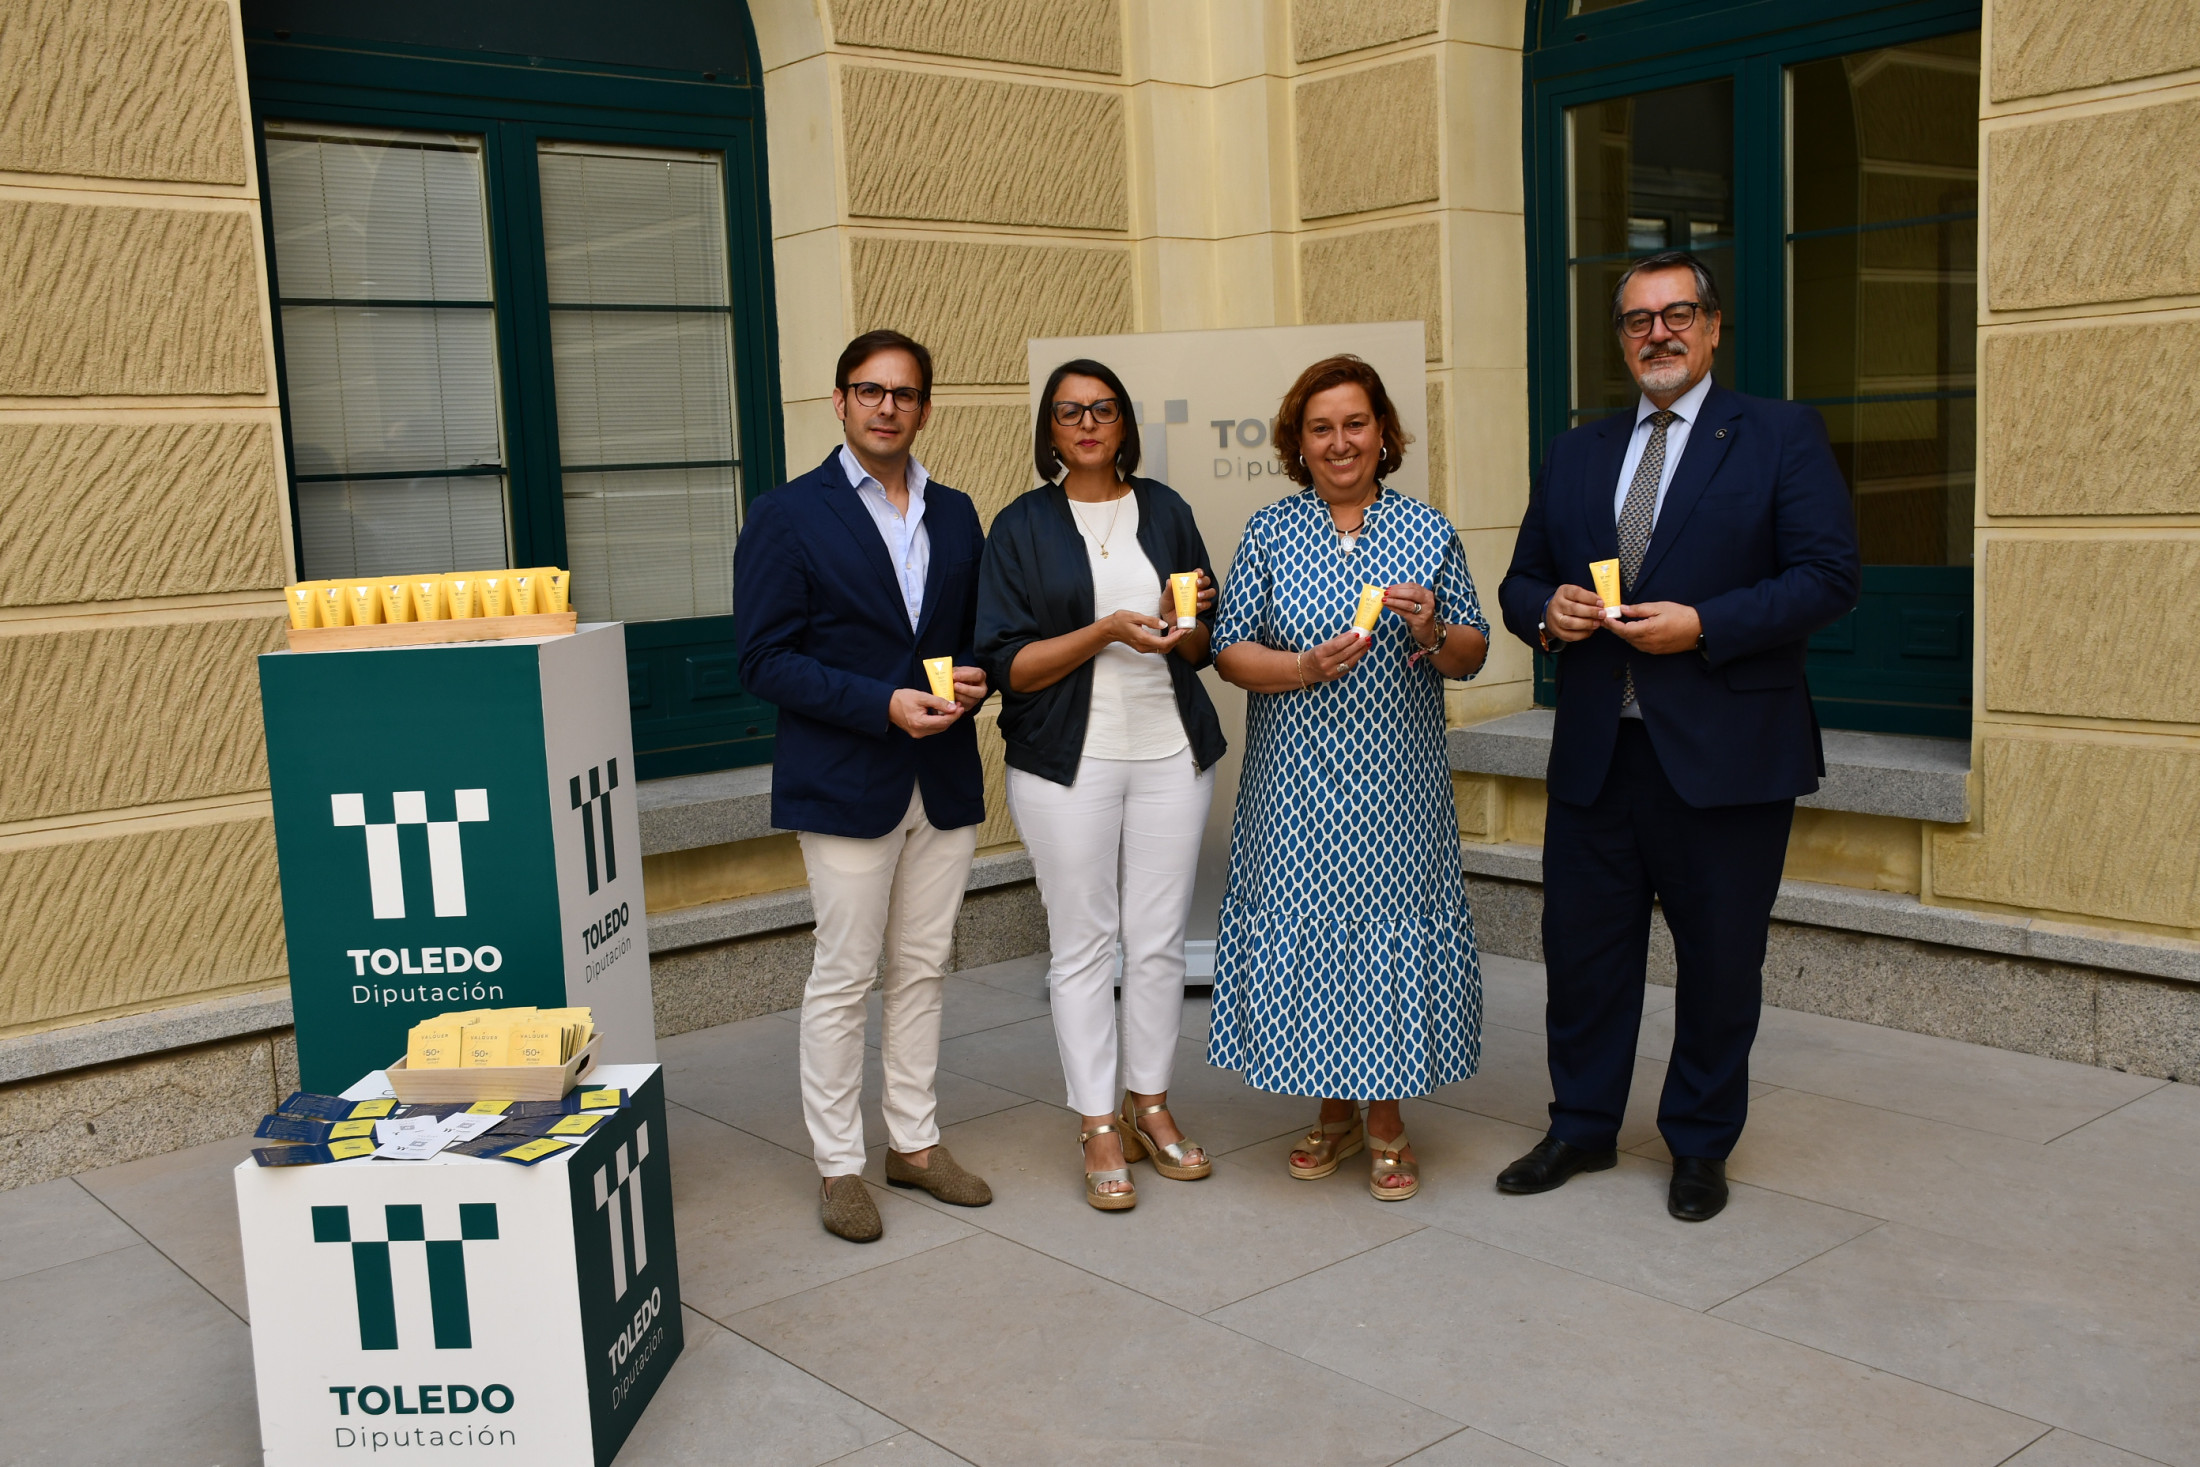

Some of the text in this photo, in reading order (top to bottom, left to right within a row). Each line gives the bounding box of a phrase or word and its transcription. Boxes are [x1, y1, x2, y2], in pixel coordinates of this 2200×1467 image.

[582, 902, 629, 955] TOLEDO
[346, 945, 503, 976] TOLEDO
[585, 937, 632, 984] Diputación
[352, 981, 504, 1007] Diputación
[608, 1286, 661, 1376] TOLEDO
[612, 1326, 664, 1410] Diputación
[329, 1383, 515, 1416] TOLEDO
[335, 1424, 516, 1452] Diputación
